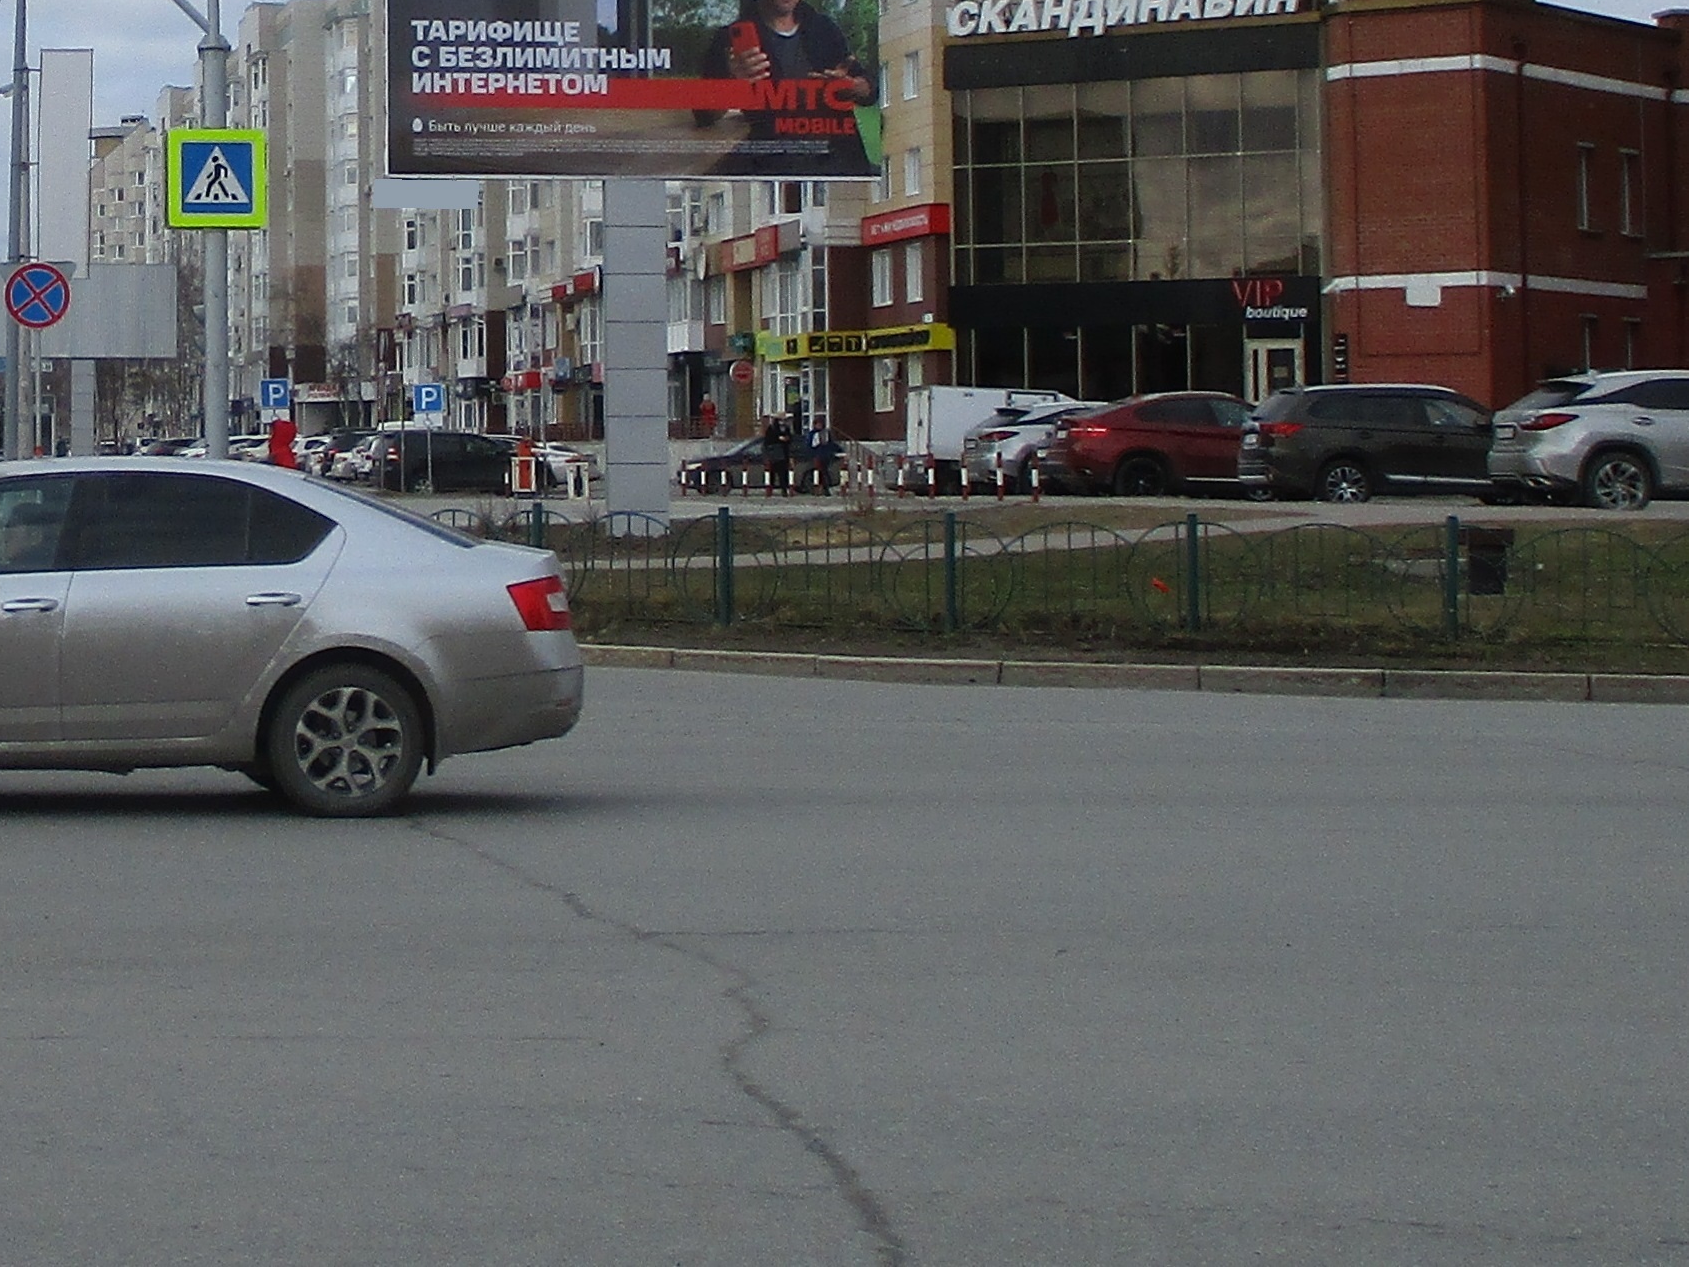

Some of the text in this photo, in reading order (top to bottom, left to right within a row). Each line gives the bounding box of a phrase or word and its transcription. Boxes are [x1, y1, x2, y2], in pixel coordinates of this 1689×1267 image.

[411, 20, 580, 45] ТАРИФИЩЕ
[411, 46, 671, 70] С БЕЗЛИМИТНЫМ
[411, 72, 608, 95] ИНТЕРНЕТОМ
[428, 120, 597, 134] Быть лучше каждый день
[775, 117, 856, 134] MOBILE
[1232, 279, 1283, 307] VIP
[1245, 306, 1308, 320] boutique
